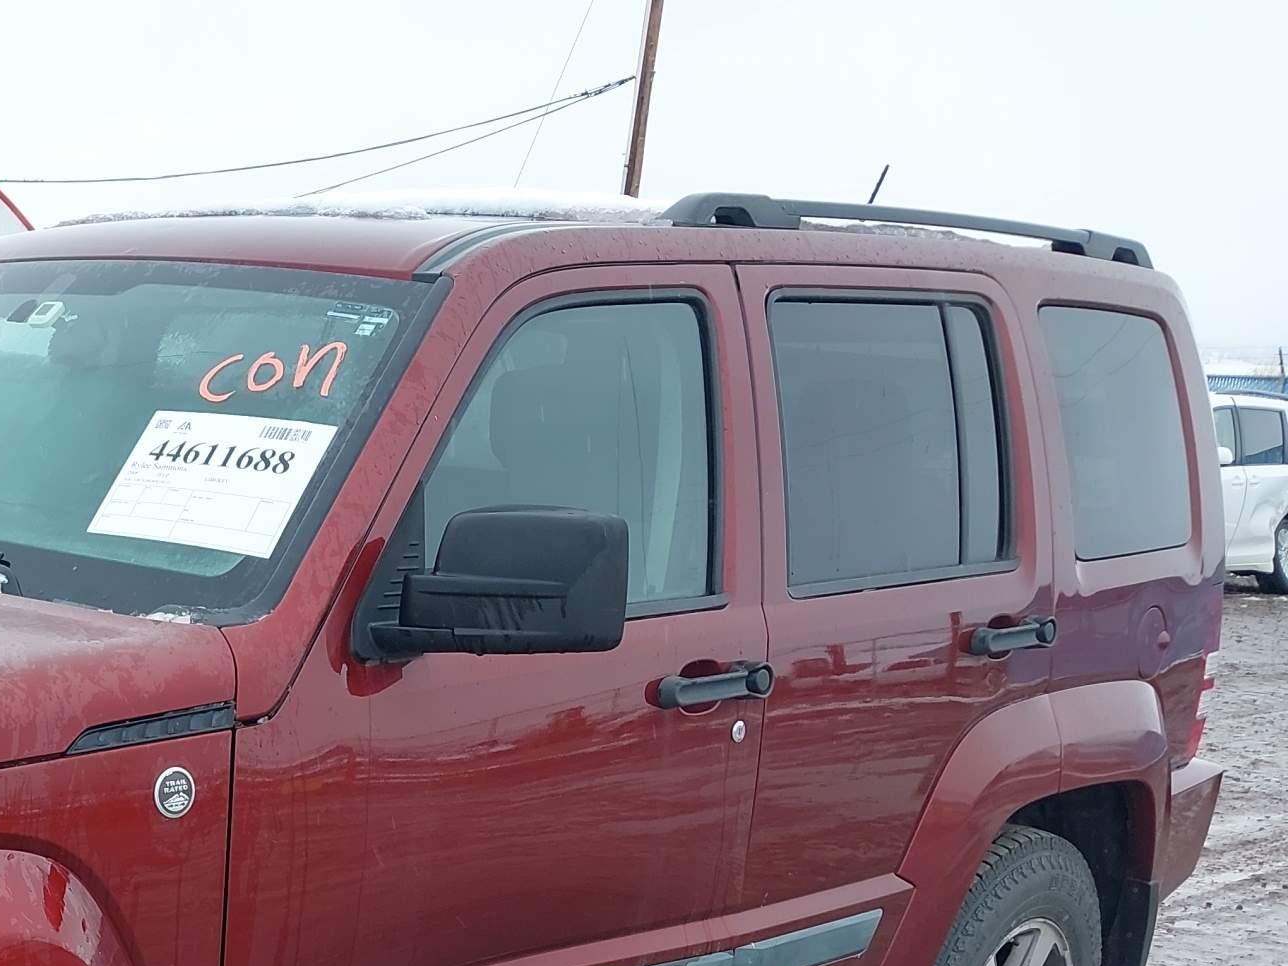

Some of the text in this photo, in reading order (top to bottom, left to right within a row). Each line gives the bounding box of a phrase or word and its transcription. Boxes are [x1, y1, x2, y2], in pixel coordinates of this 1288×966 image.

[149, 439, 296, 475] 44611688
[165, 779, 187, 787] TRAIL
[163, 784, 188, 794] RATED
